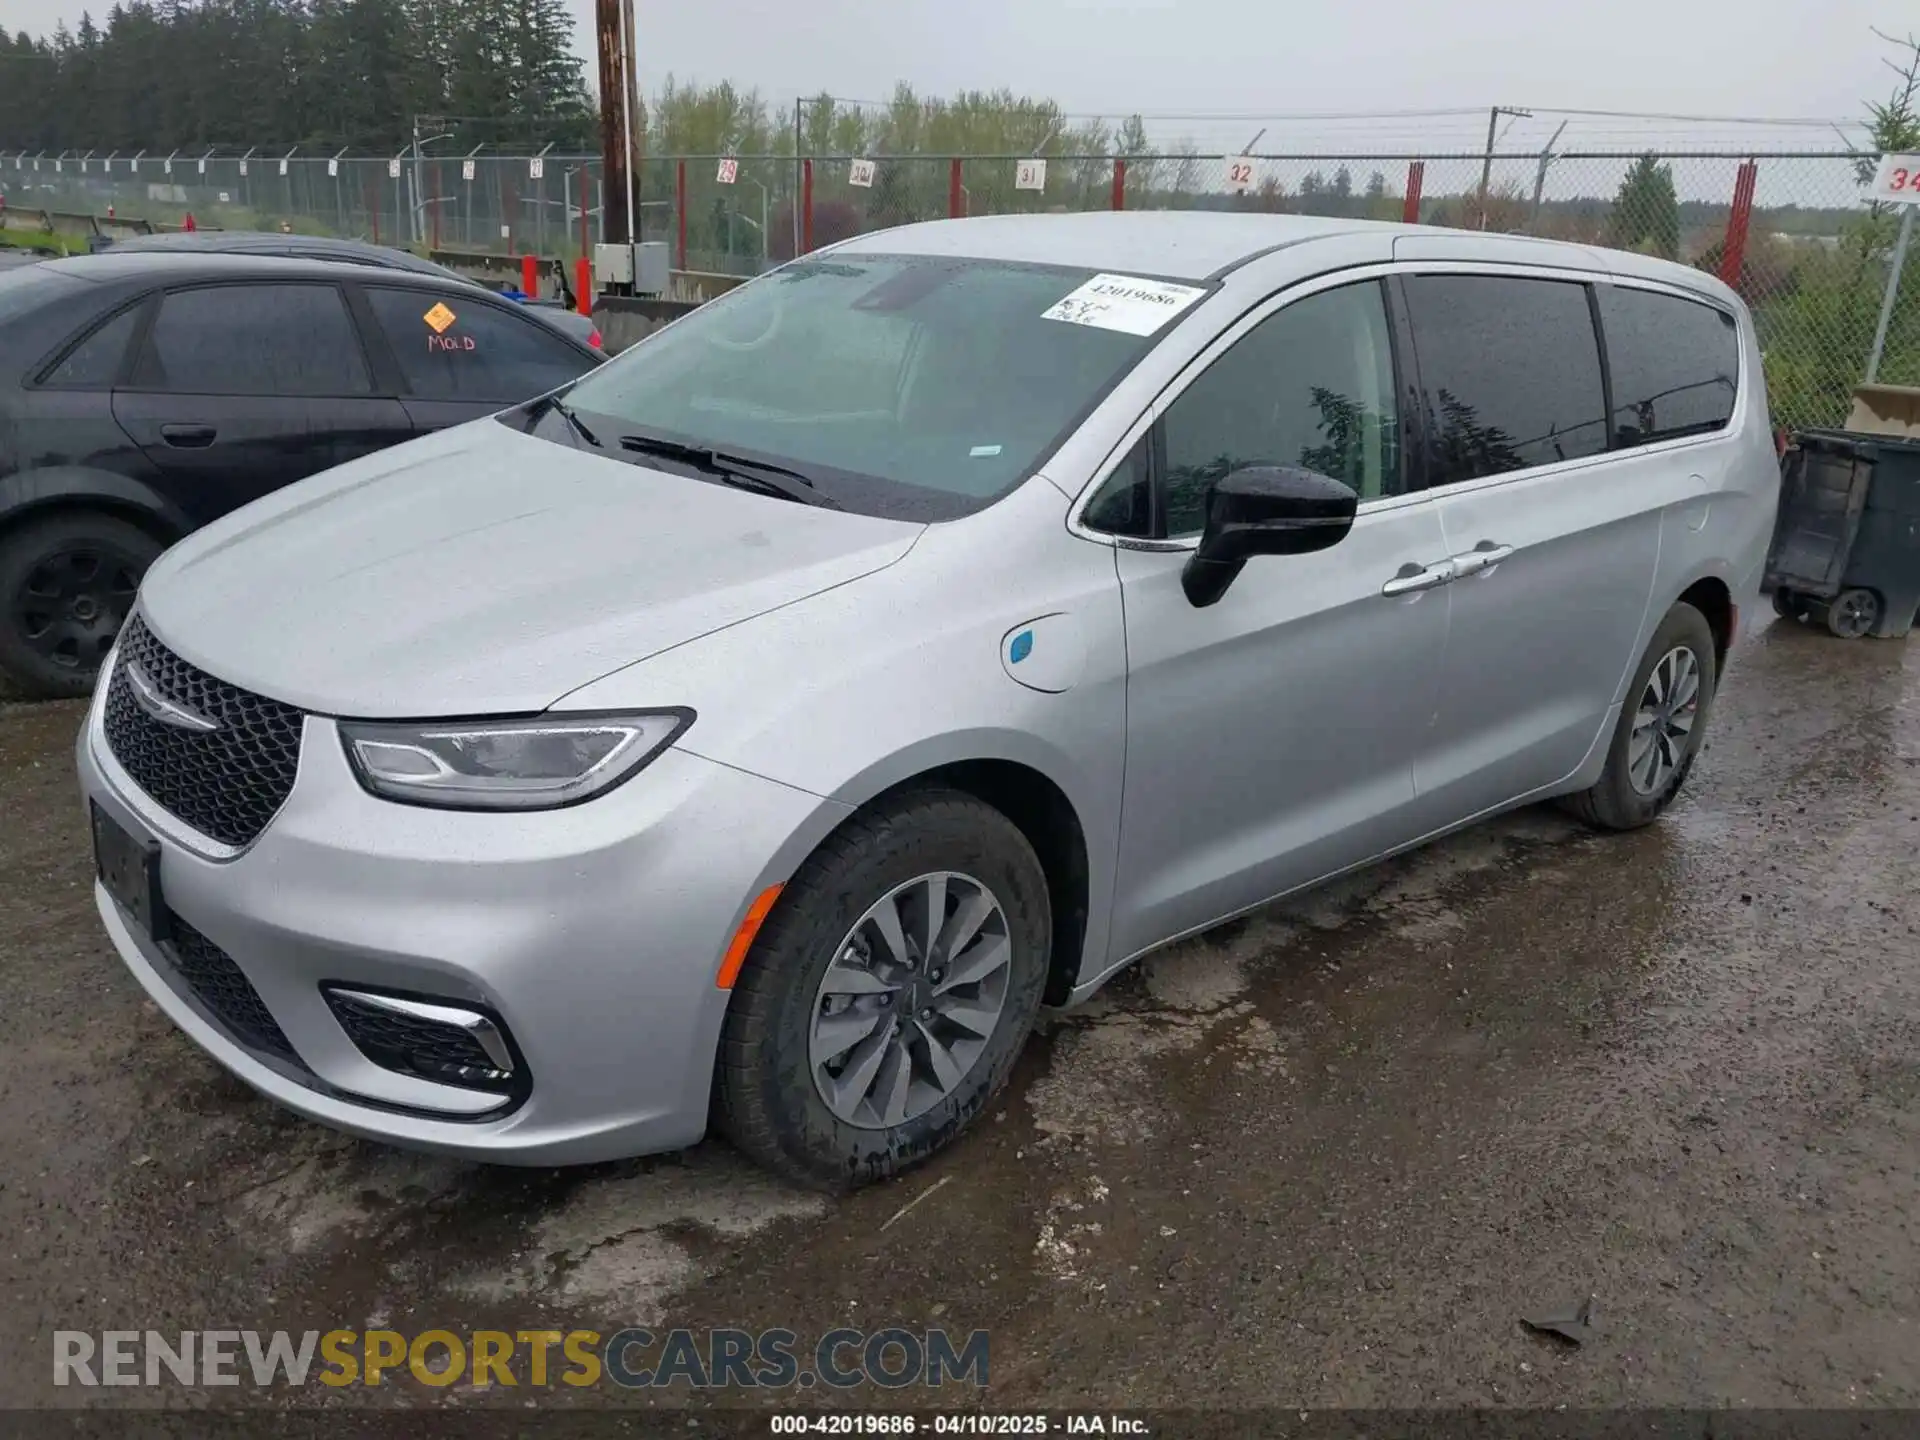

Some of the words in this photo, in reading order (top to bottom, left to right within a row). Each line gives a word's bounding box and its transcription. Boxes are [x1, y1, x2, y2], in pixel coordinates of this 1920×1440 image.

[1022, 167, 1036, 183] 31
[1231, 164, 1251, 183] 32
[1090, 284, 1176, 305] 42019686
[428, 335, 475, 352] MOLD
